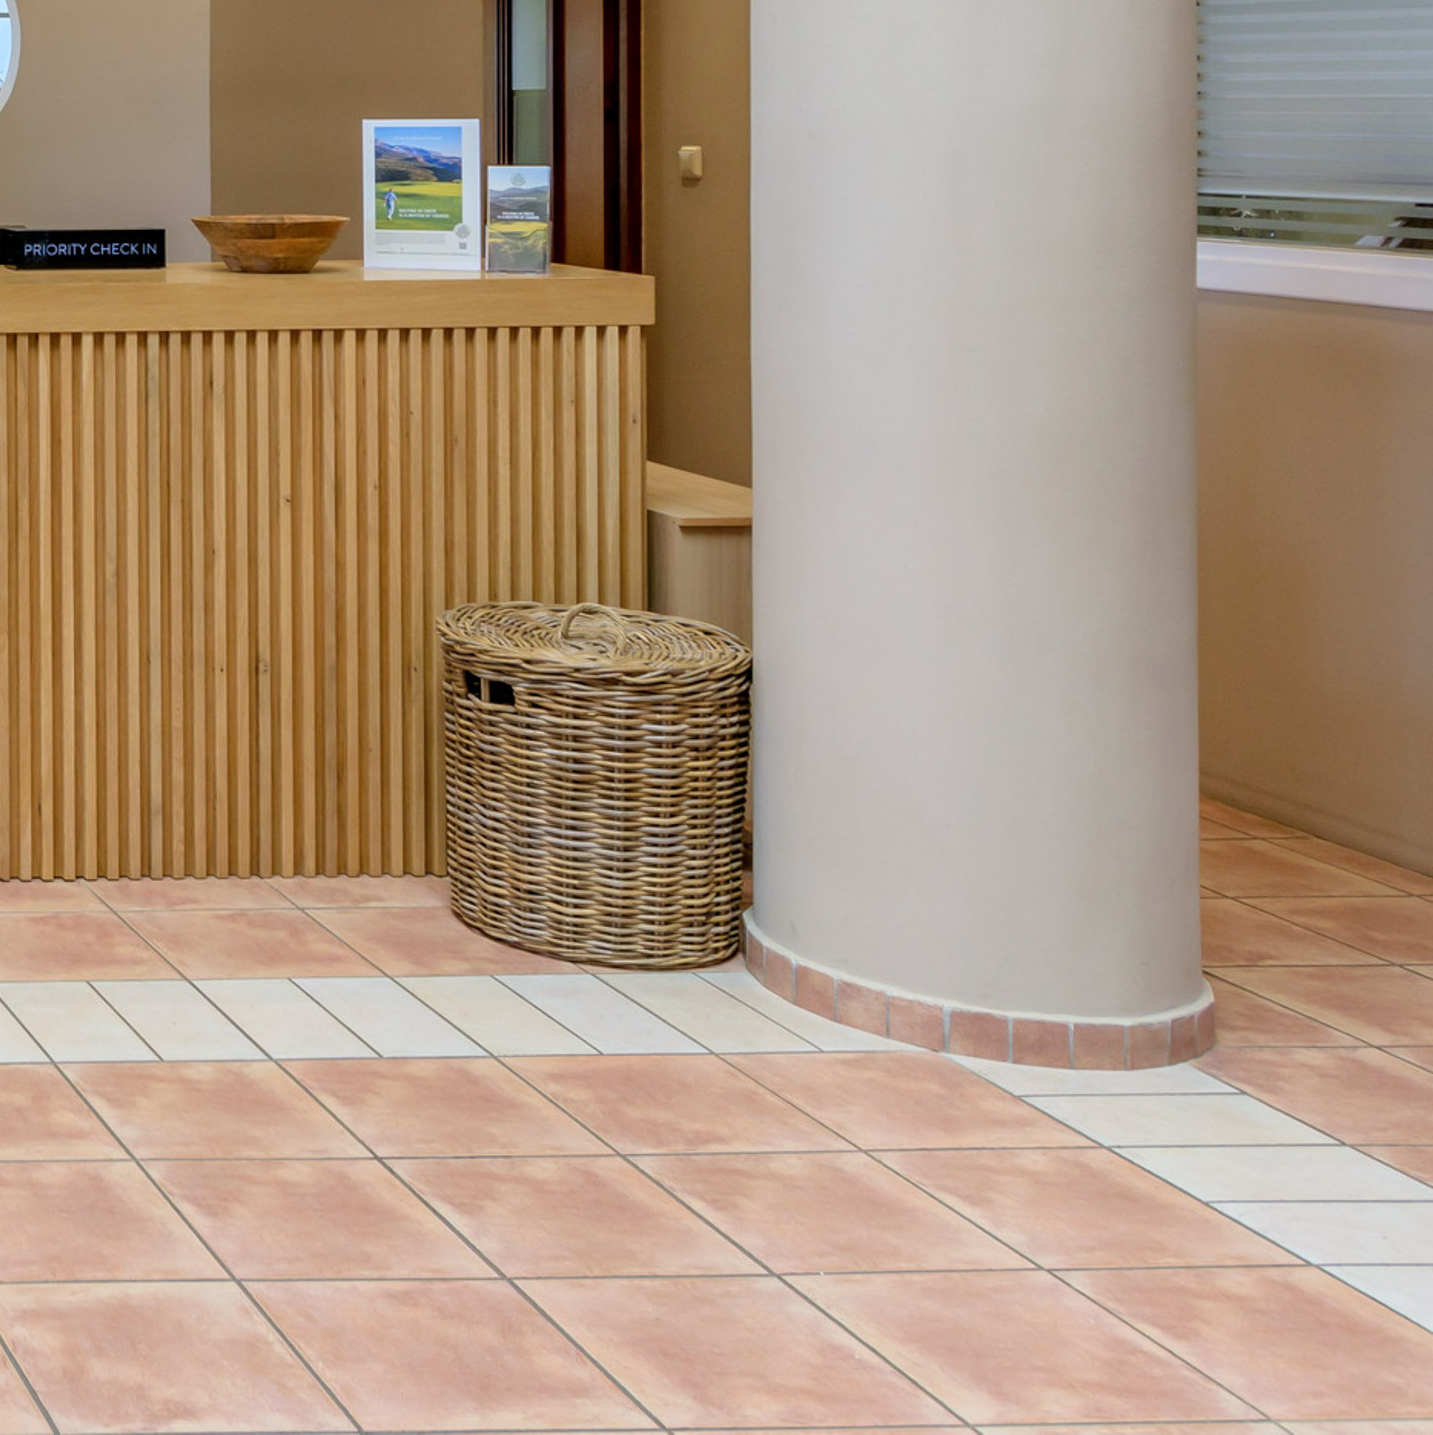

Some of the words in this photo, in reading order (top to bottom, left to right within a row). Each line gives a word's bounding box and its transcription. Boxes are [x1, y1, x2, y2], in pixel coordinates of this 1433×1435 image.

[24, 243, 87, 256] PRIORITY
[90, 243, 139, 255] CHECK
[142, 243, 157, 255] IN
